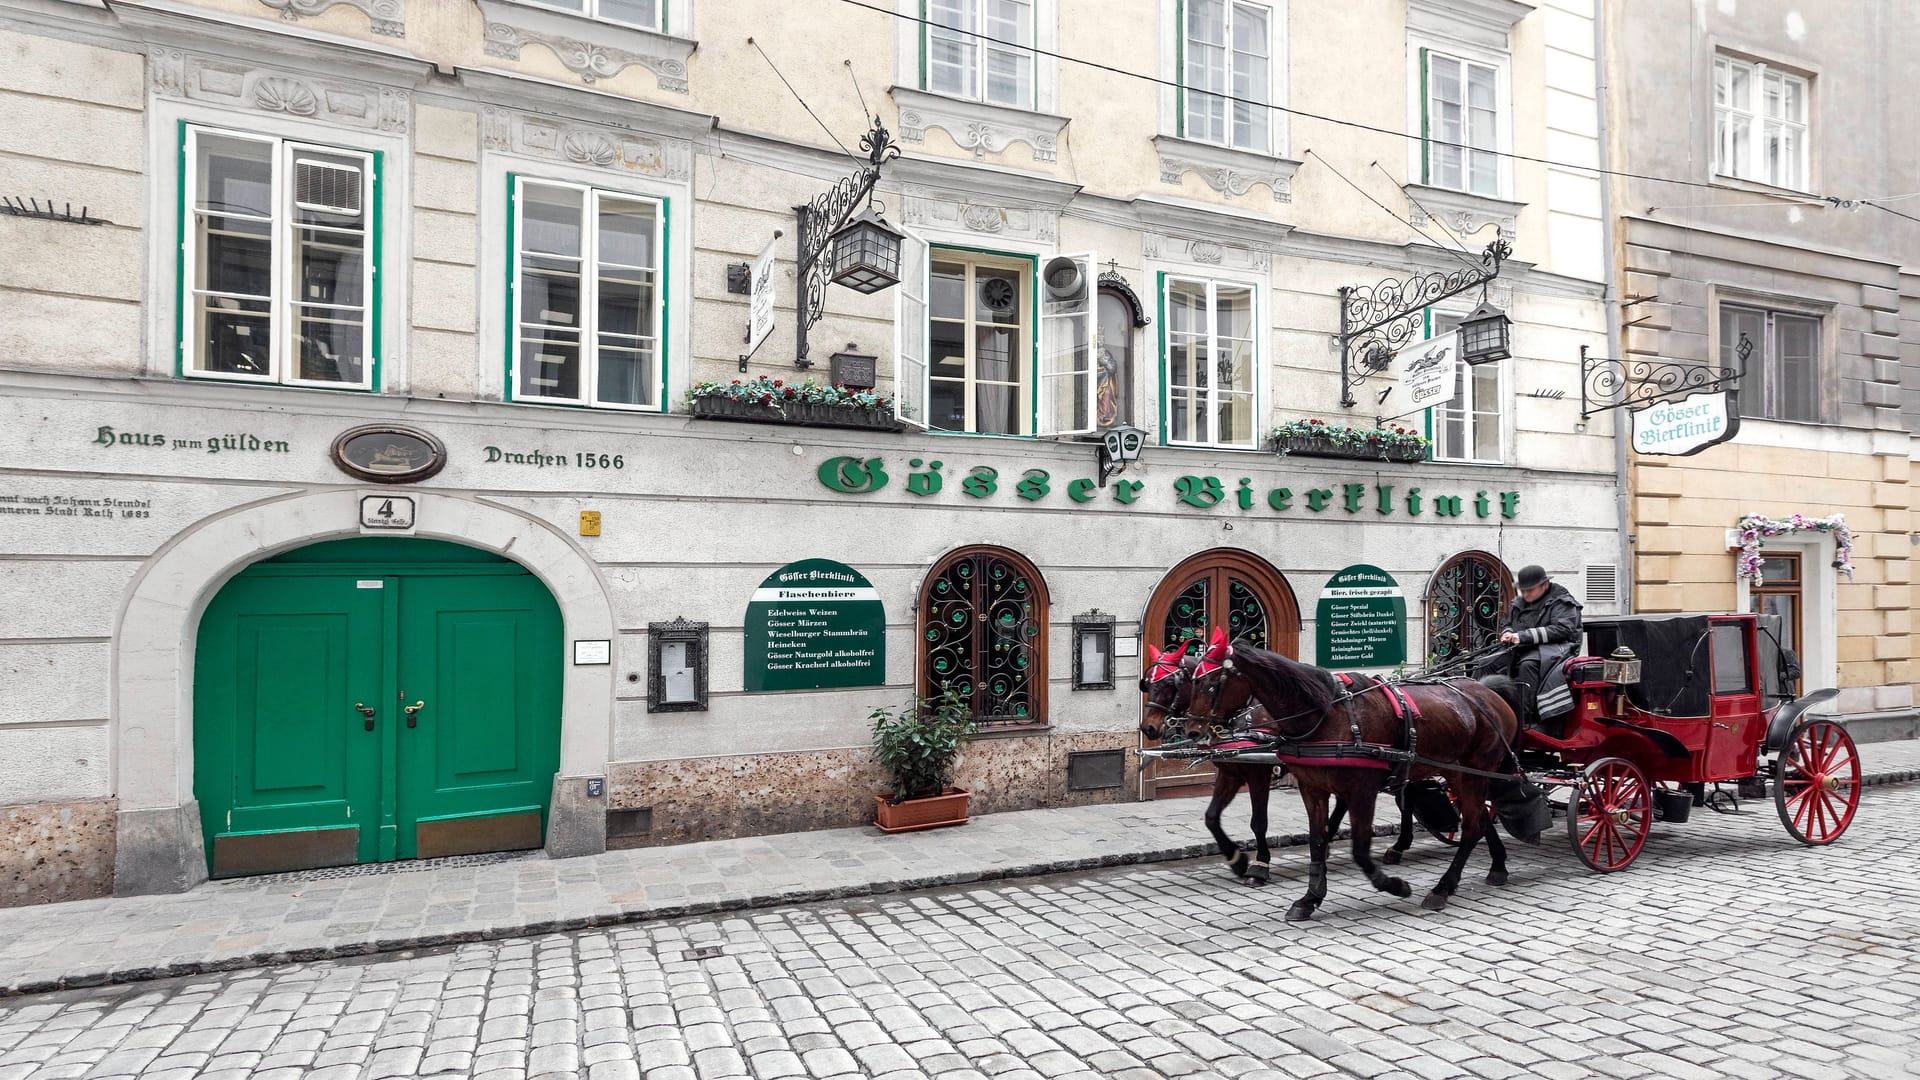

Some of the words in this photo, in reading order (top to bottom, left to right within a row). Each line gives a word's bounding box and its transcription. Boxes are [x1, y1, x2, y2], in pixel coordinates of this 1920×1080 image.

[1650, 403, 1710, 425] Gösser
[1640, 415, 1721, 445] Bierklinik
[92, 425, 166, 448] Haus
[172, 438, 202, 450] zum
[207, 434, 290, 454] gülden
[483, 446, 568, 469] Drachen
[576, 452, 624, 469] 1566
[818, 455, 1145, 505] Gösser
[1174, 475, 1521, 519] Bierklinik
[23, 495, 50, 506] nach
[53, 495, 101, 507] Johann
[45, 506, 79, 516] Stadt
[83, 507, 113, 519] Rath
[122, 510, 150, 518] 1683
[377, 499, 394, 518] 4
[810, 570, 855, 583] Bierklinik
[779, 590, 856, 598] Flaschenbiere
[767, 609, 807, 617] Edelweiss
[808, 608, 838, 616] Weizen
[1350, 603, 1369, 611] Spezial
[797, 619, 828, 627] Märzen
[767, 630, 821, 639] Wieselburger
[823, 629, 868, 637] Stammbräu
[767, 641, 807, 649] Heineken
[795, 650, 833, 660] Naturgold
[834, 649, 875, 657] alkoholfrei
[767, 662, 793, 670] Gösser
[795, 661, 829, 669] Kracherl
[831, 659, 871, 668] alkoholfrei
